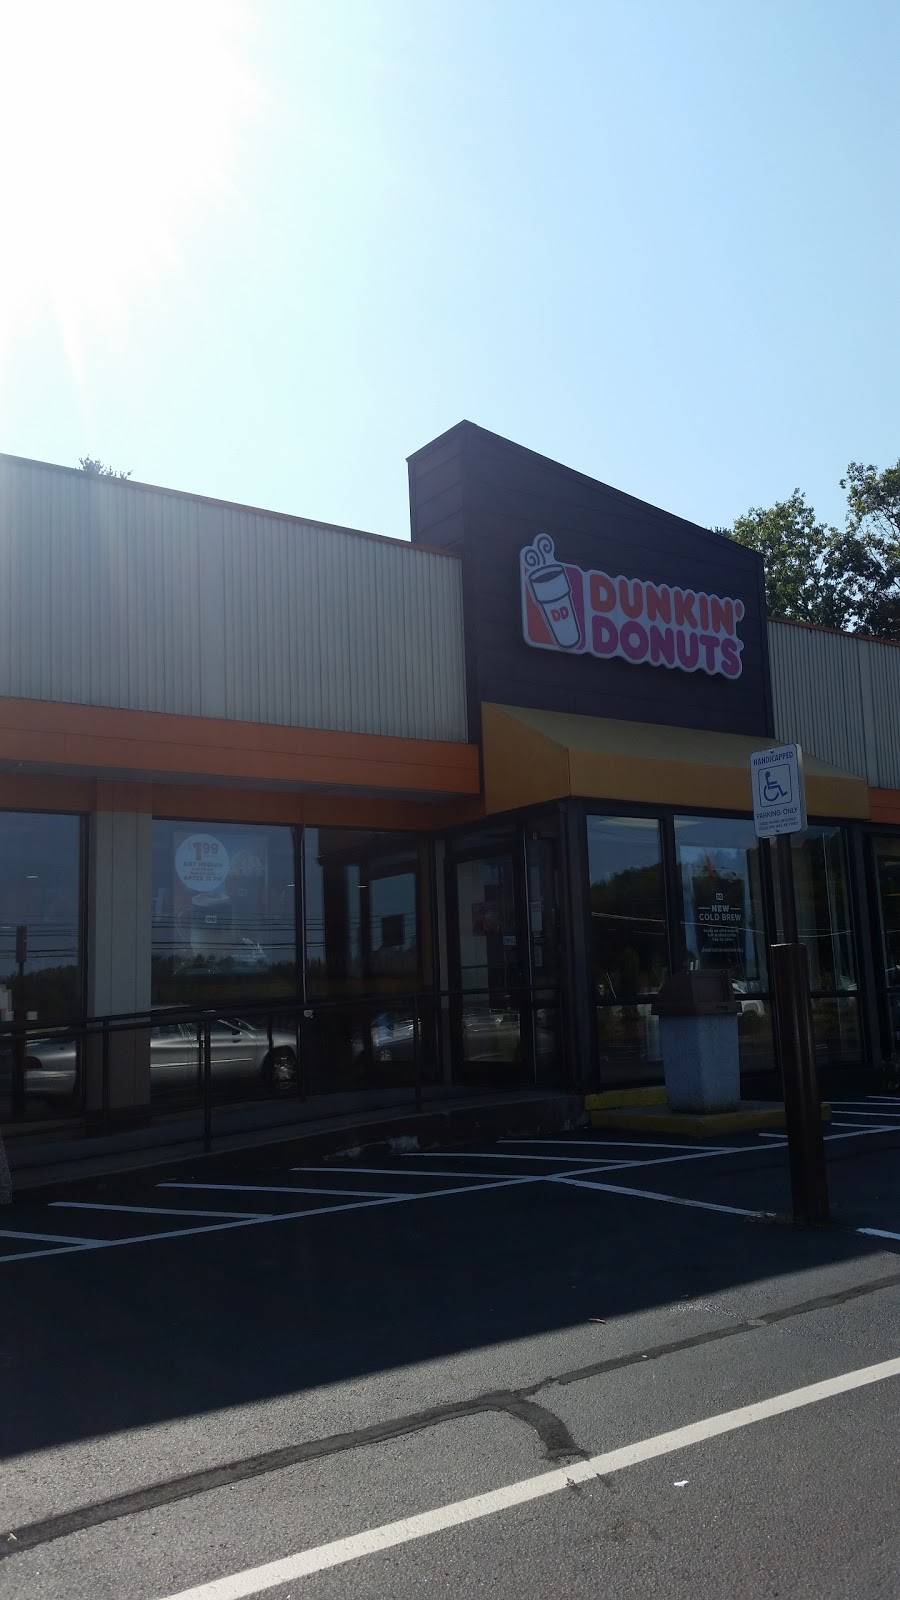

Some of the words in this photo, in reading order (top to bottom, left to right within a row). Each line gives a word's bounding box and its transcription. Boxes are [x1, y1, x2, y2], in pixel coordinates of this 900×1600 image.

[589, 575, 743, 635] DUNKIN'
[551, 606, 568, 622] DD
[592, 615, 741, 676] DONUTS
[753, 751, 793, 766] HANDICAPPED
[782, 807, 798, 815] ONLY
[711, 905, 730, 913] NEW
[699, 913, 720, 921] COLD
[721, 913, 742, 921] BREW
